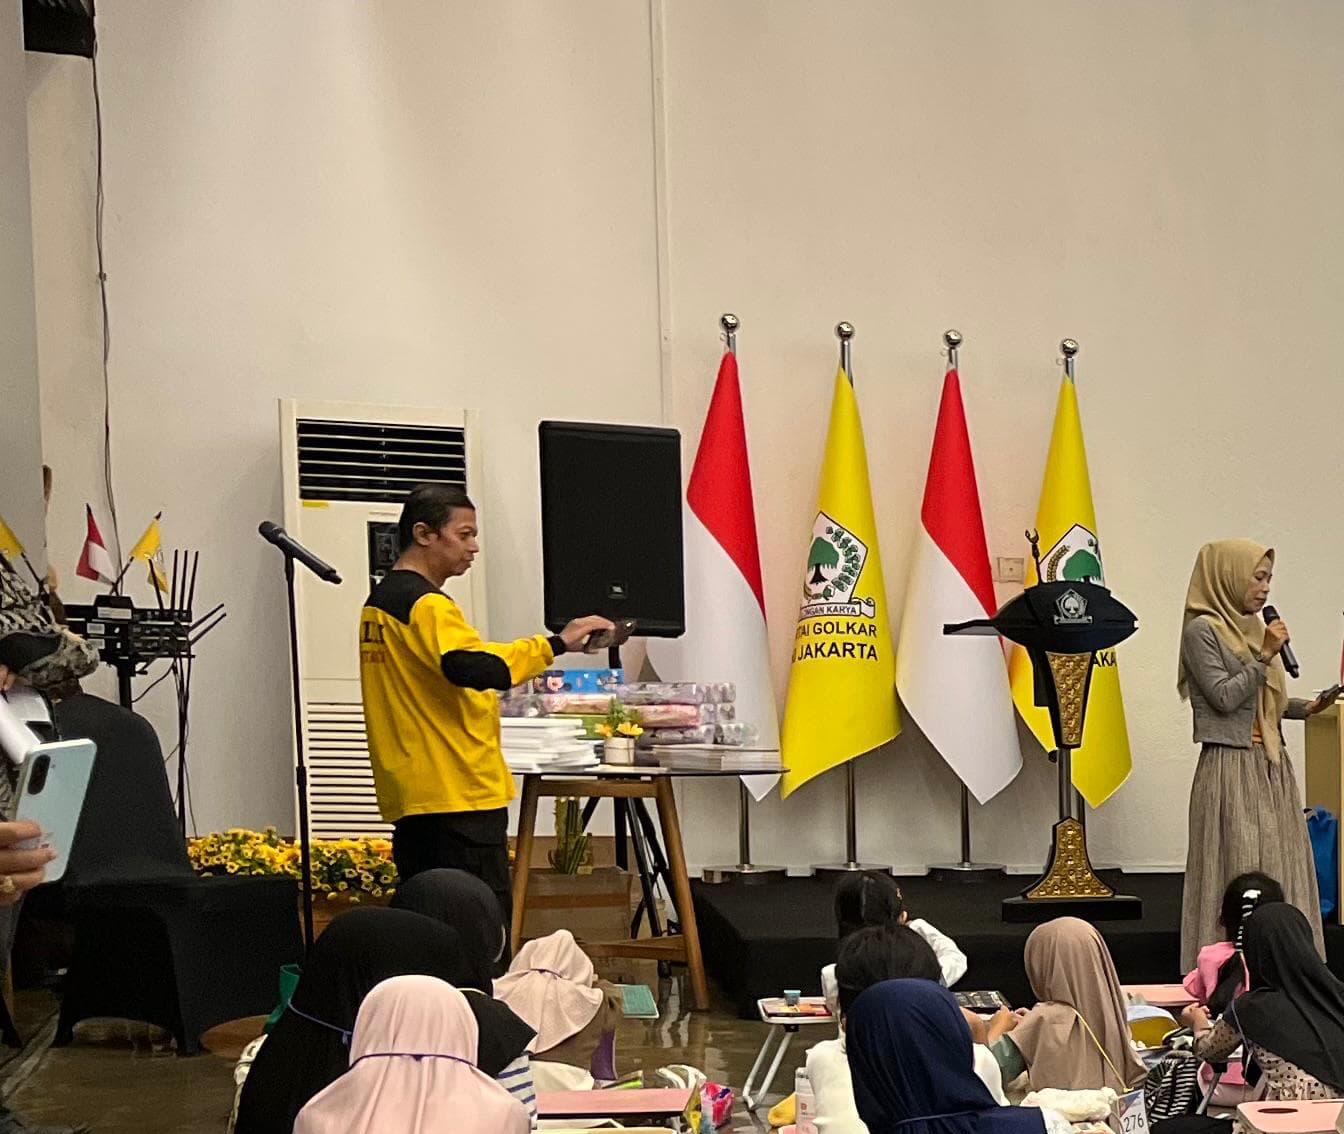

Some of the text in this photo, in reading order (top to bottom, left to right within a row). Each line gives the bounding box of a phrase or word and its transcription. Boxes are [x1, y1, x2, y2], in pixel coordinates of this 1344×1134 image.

[813, 621, 878, 638] GOLKAR
[798, 641, 878, 661] JAKARTA
[1123, 1112, 1145, 1133] 276
